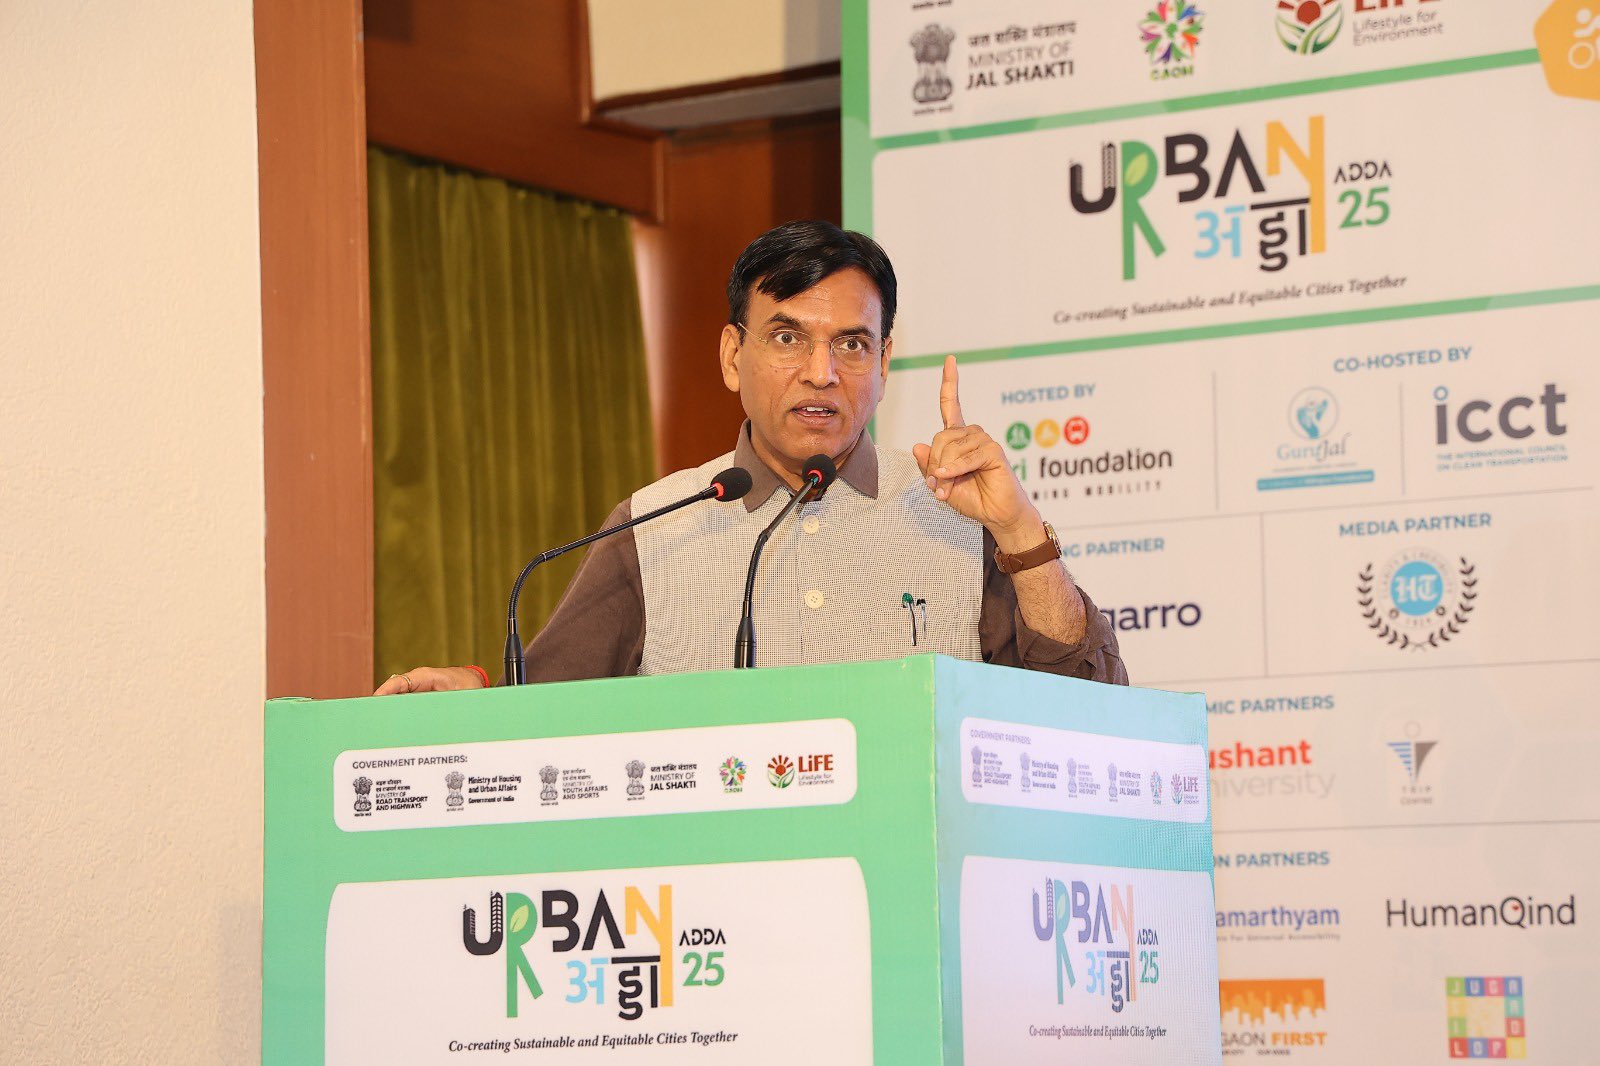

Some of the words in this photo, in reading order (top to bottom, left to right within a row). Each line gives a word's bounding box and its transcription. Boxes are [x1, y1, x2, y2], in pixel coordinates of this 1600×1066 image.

[1353, 23, 1443, 46] Environment
[968, 46, 1044, 68] MINISTRY
[1049, 41, 1071, 58] OF
[966, 73, 997, 91] JAL
[1005, 60, 1074, 85] SHAKTI
[1334, 160, 1392, 185] ADDA
[1069, 115, 1326, 281] URBAN
[1338, 186, 1391, 230] 25
[1053, 304, 1127, 325] Co-creating
[1130, 295, 1205, 317] Sustainable
[1209, 291, 1235, 307] and
[1238, 283, 1302, 306] Equitable
[1305, 278, 1344, 298] Cities
[1348, 275, 1407, 297] Together
[1333, 350, 1442, 373] CO-HOSTED
[1448, 346, 1472, 362] BY
[1001, 385, 1069, 405] HOSTED
[1073, 383, 1096, 399] BY
[1433, 383, 1567, 445] icct
[1040, 448, 1173, 479] foundation
[1338, 520, 1399, 537] MEDIA
[1404, 513, 1492, 532] PARTNER
[1086, 537, 1165, 557] PARTNER
[1240, 695, 1335, 713] PARTNERS
[970, 729, 1004, 740] GOVERNMENT
[352, 757, 415, 769] GOVERNMENT
[418, 754, 468, 766] PARTNERS:
[798, 754, 833, 773] LiFE
[468, 776, 490, 785] Ministry
[491, 775, 497, 783] of
[499, 774, 522, 783] Housing
[480, 785, 497, 793] Urban
[498, 784, 518, 792] Affairs
[650, 772, 684, 782] MINISTRY
[650, 783, 664, 791] JAL
[666, 780, 696, 790] SHAKTI
[394, 796, 428, 804] TRANSPORT
[1236, 851, 1331, 868] PARTNERS
[1386, 894, 1576, 929] HumanQind
[679, 928, 727, 947] ADDA
[1032, 875, 1137, 1005] URBAN
[1137, 928, 1159, 946] ADDA
[463, 884, 674, 1018] URBAN
[682, 951, 725, 987] 25
[1139, 950, 1159, 984] 25
[449, 1040, 510, 1053] Co-creating
[513, 1036, 575, 1050] Sustainable
[578, 1035, 599, 1048] and
[602, 1033, 654, 1049] Equitable
[656, 1031, 687, 1045] Cities
[690, 1030, 738, 1046] Together
[1029, 1025, 1061, 1040] Co-creating
[1062, 1025, 1092, 1038] Sustainable
[1093, 1026, 1104, 1037] and
[1105, 1026, 1129, 1040] Equitable
[1130, 1026, 1144, 1038] Cities
[1145, 1026, 1167, 1040] Together
[1271, 1031, 1327, 1047] FIRST
